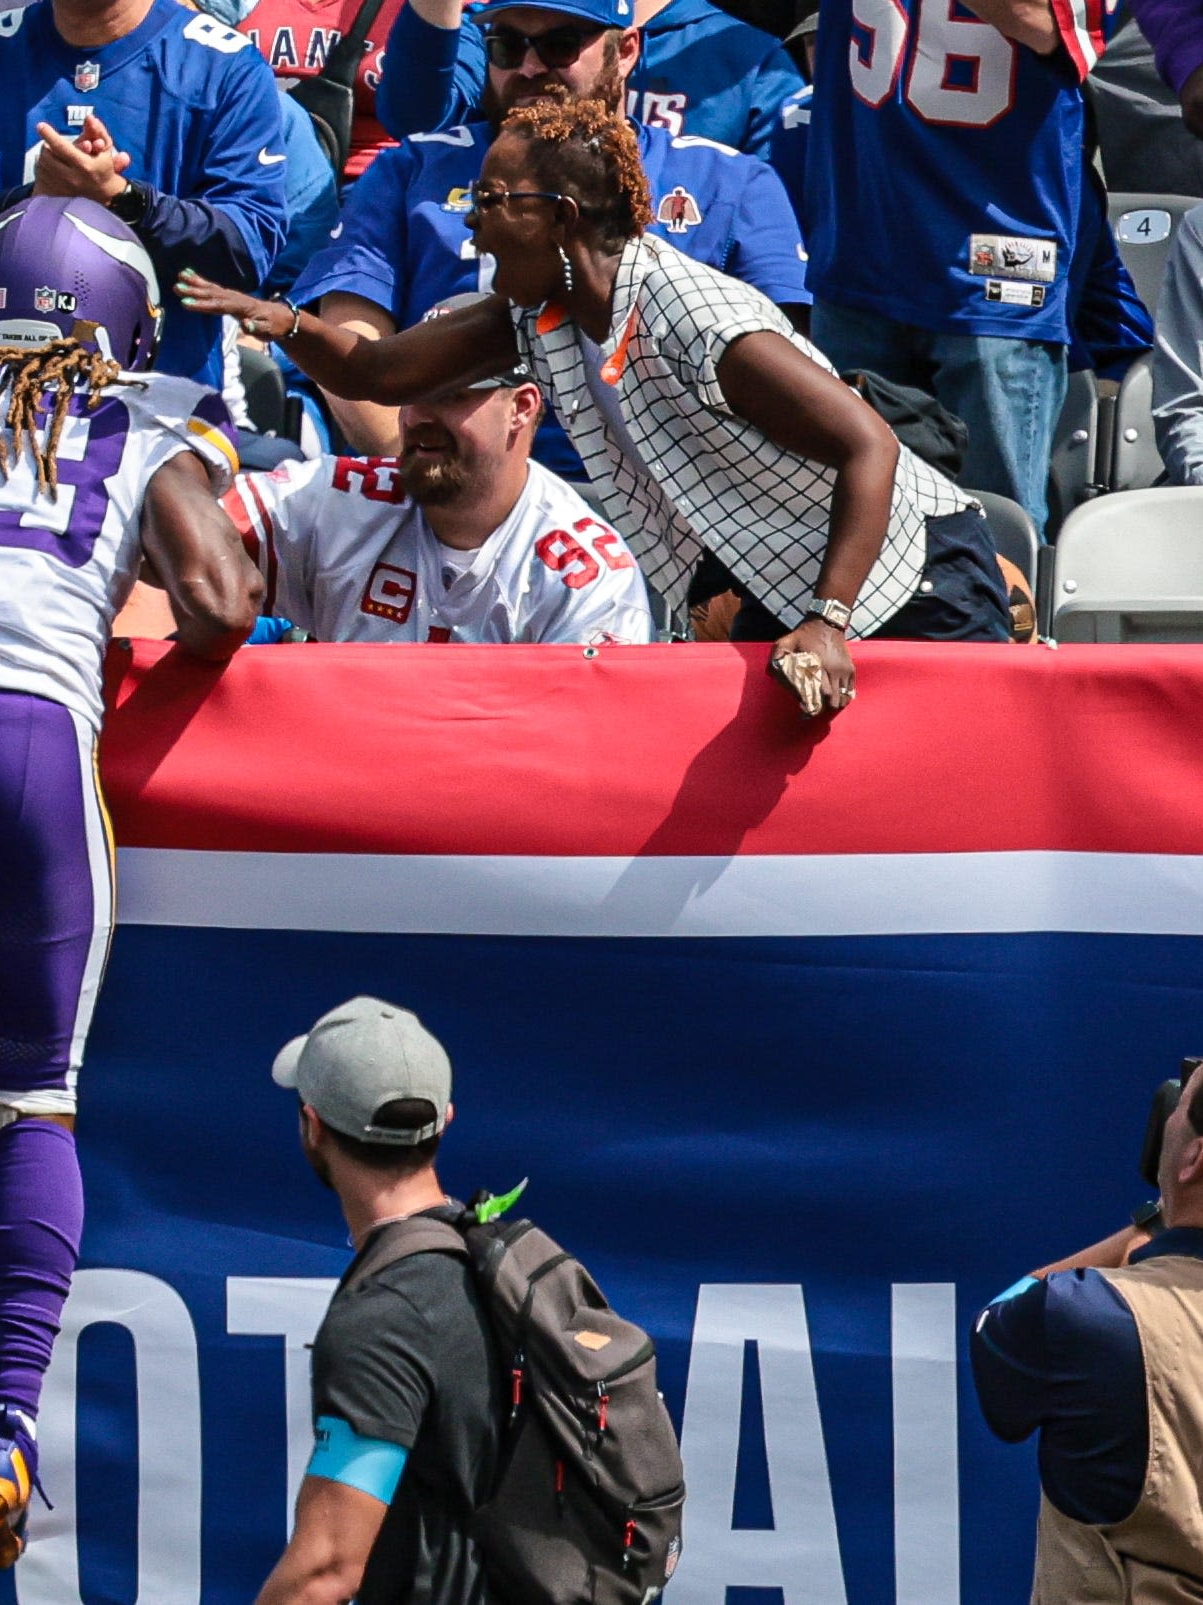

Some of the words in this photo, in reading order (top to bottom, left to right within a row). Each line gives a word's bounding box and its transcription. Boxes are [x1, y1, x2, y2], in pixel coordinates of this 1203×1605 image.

[849, 0, 1020, 129] 56
[1136, 216, 1152, 237] 4
[57, 294, 76, 311] KJ
[24, 334, 37, 342] ALL
[534, 516, 637, 590] 92
[369, 567, 413, 609] C
